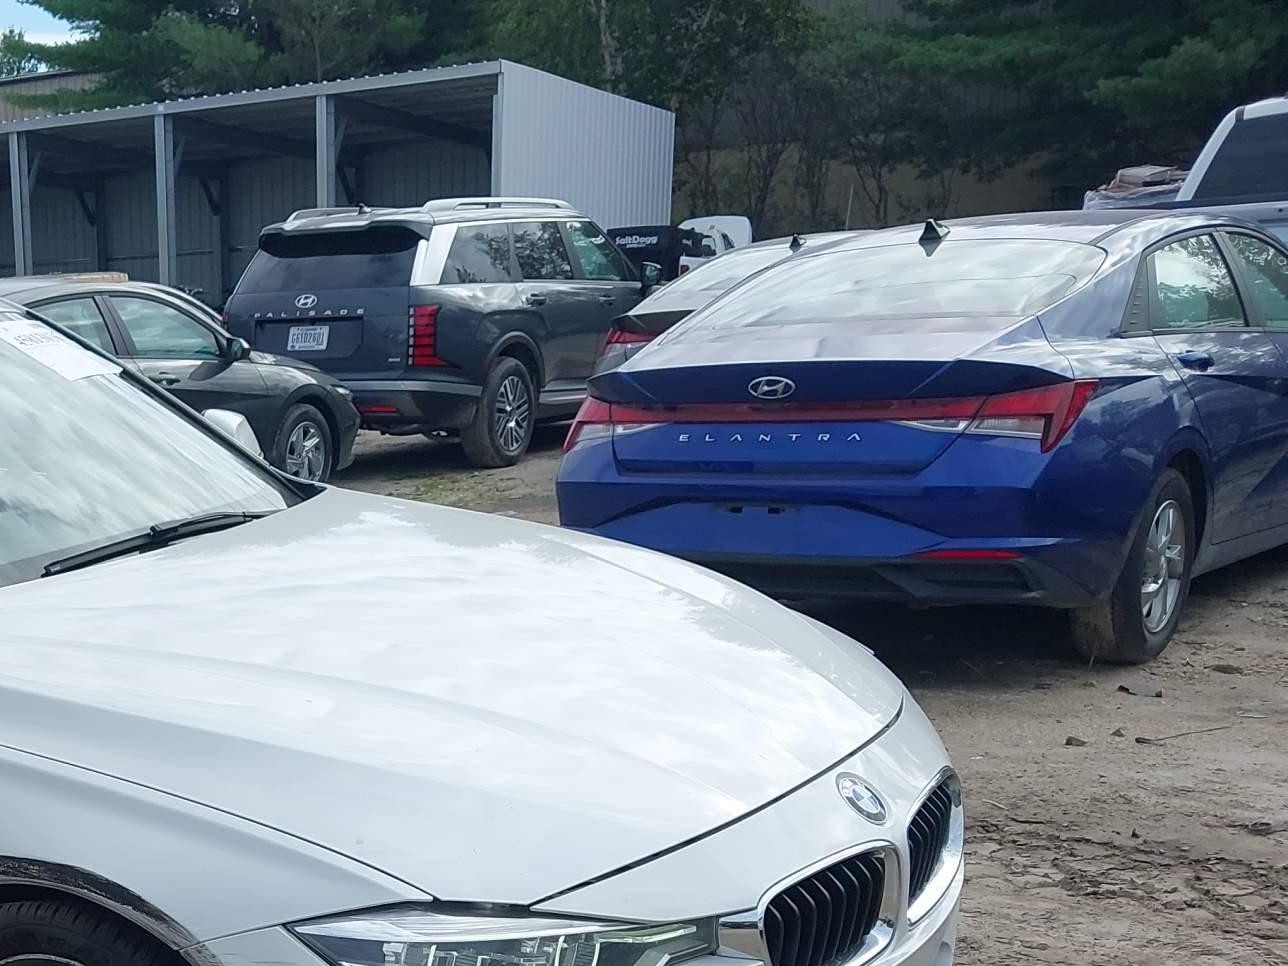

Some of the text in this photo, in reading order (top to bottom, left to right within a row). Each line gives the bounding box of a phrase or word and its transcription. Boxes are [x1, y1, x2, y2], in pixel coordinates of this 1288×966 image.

[615, 235, 659, 246] SaltDogg
[254, 308, 365, 318] PALISADE
[678, 433, 862, 443] ELANTRA
